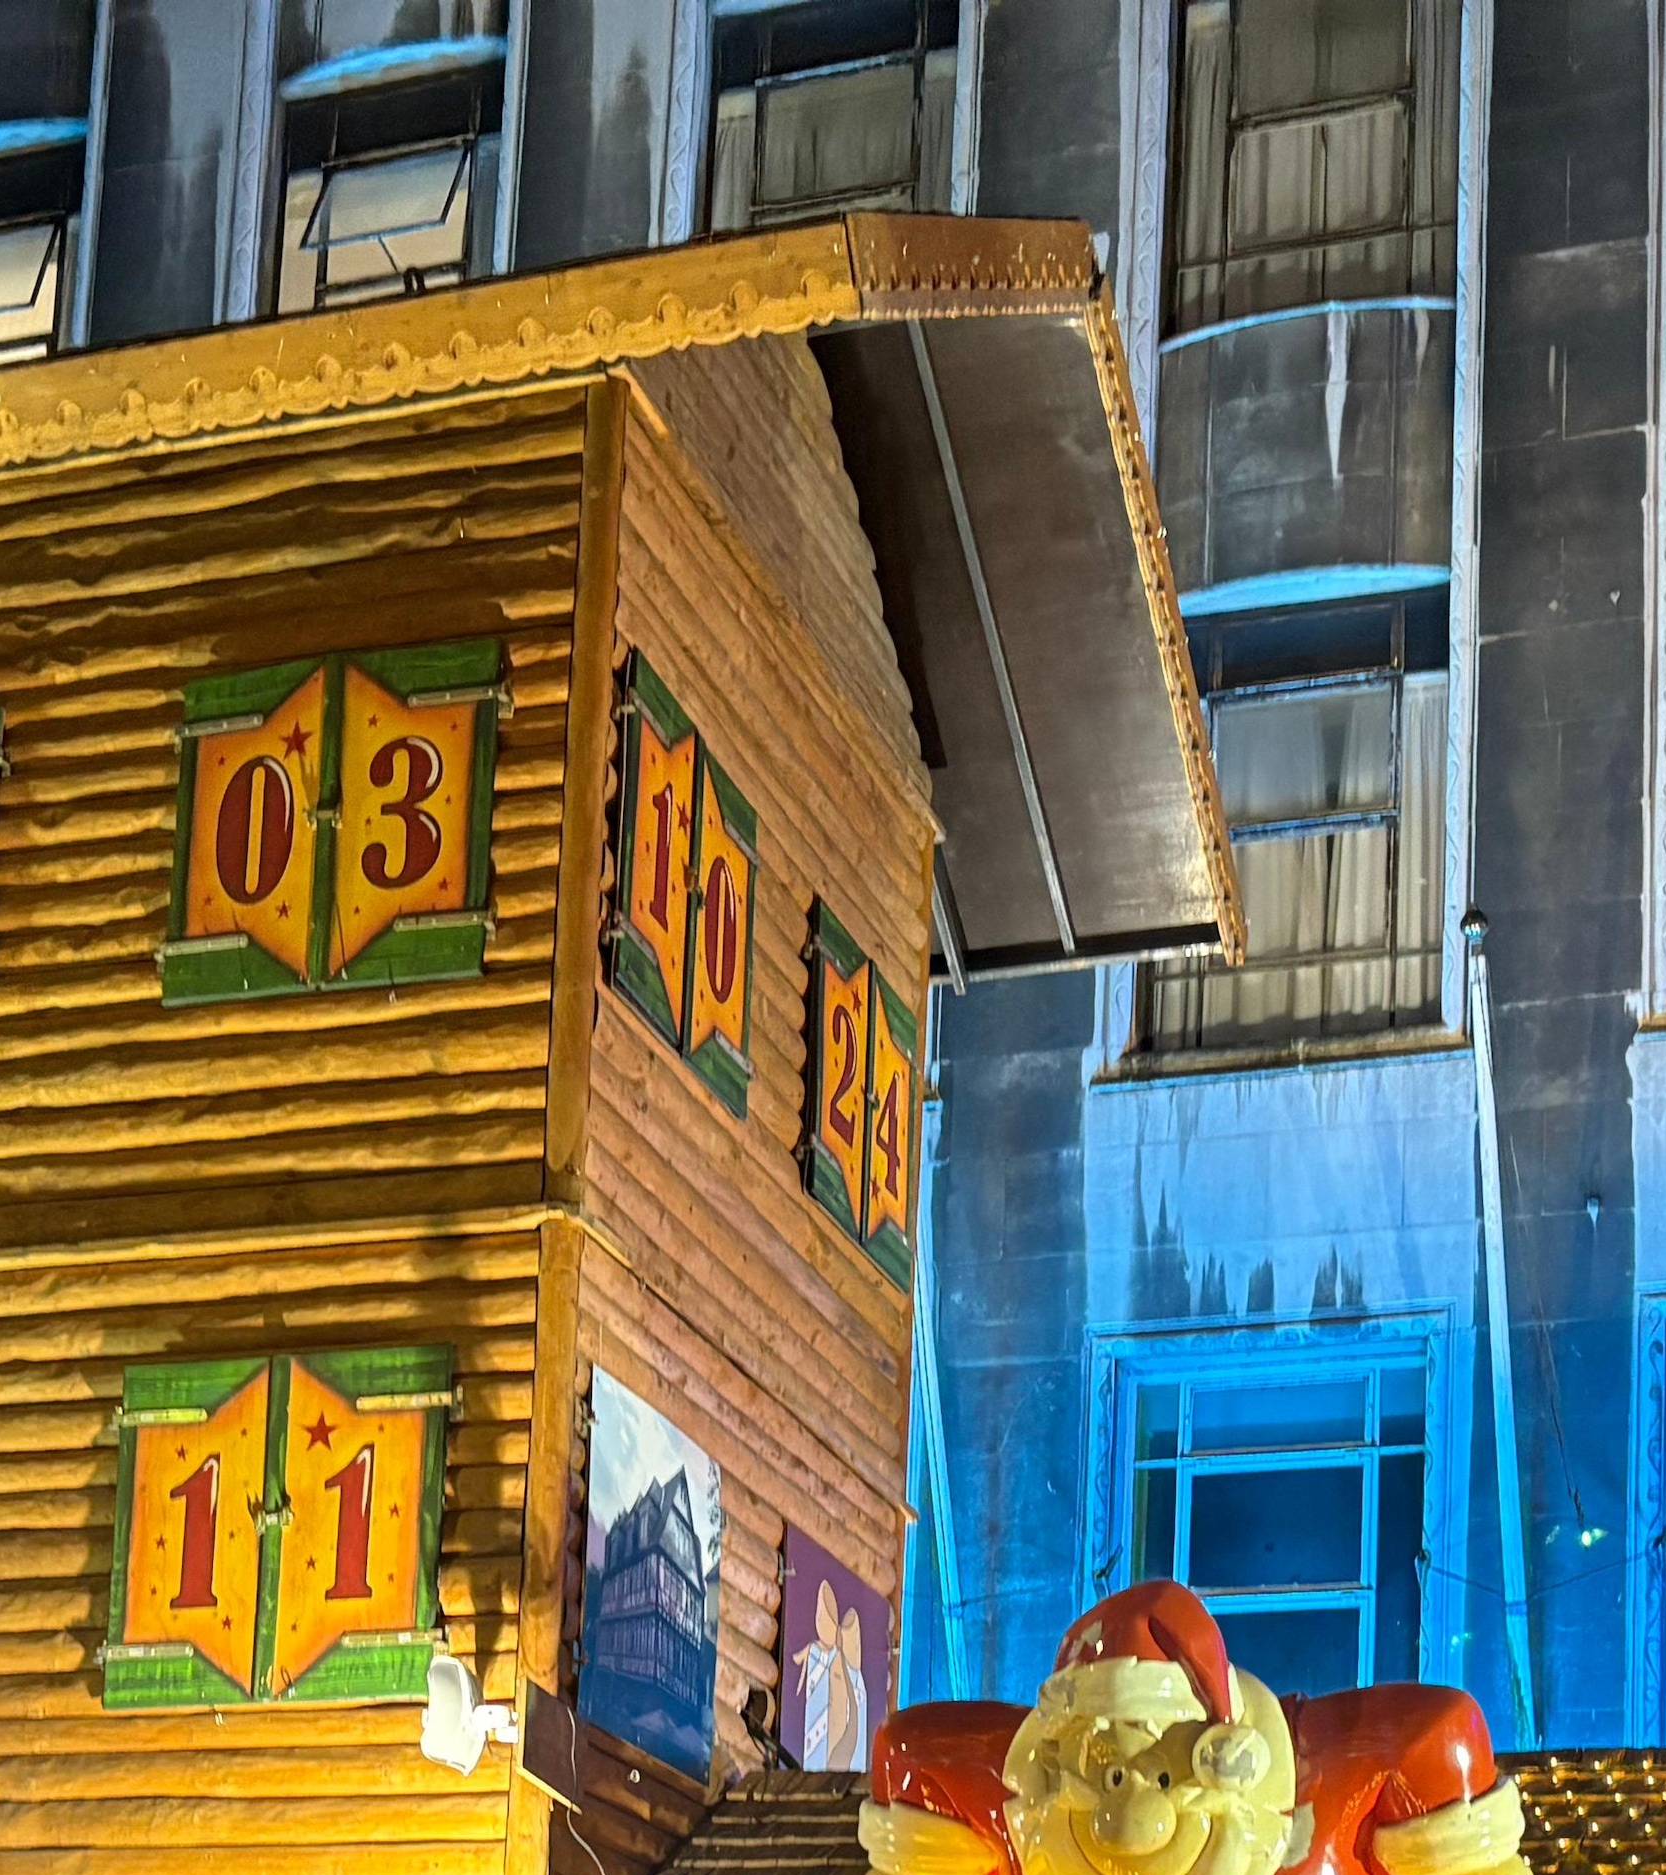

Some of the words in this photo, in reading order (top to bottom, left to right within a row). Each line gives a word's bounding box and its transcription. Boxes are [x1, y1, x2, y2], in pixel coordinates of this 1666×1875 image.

[215, 735, 444, 906] 03
[650, 782, 737, 1005] 10
[829, 1004, 901, 1201] 24
[168, 1443, 376, 1610] 11
